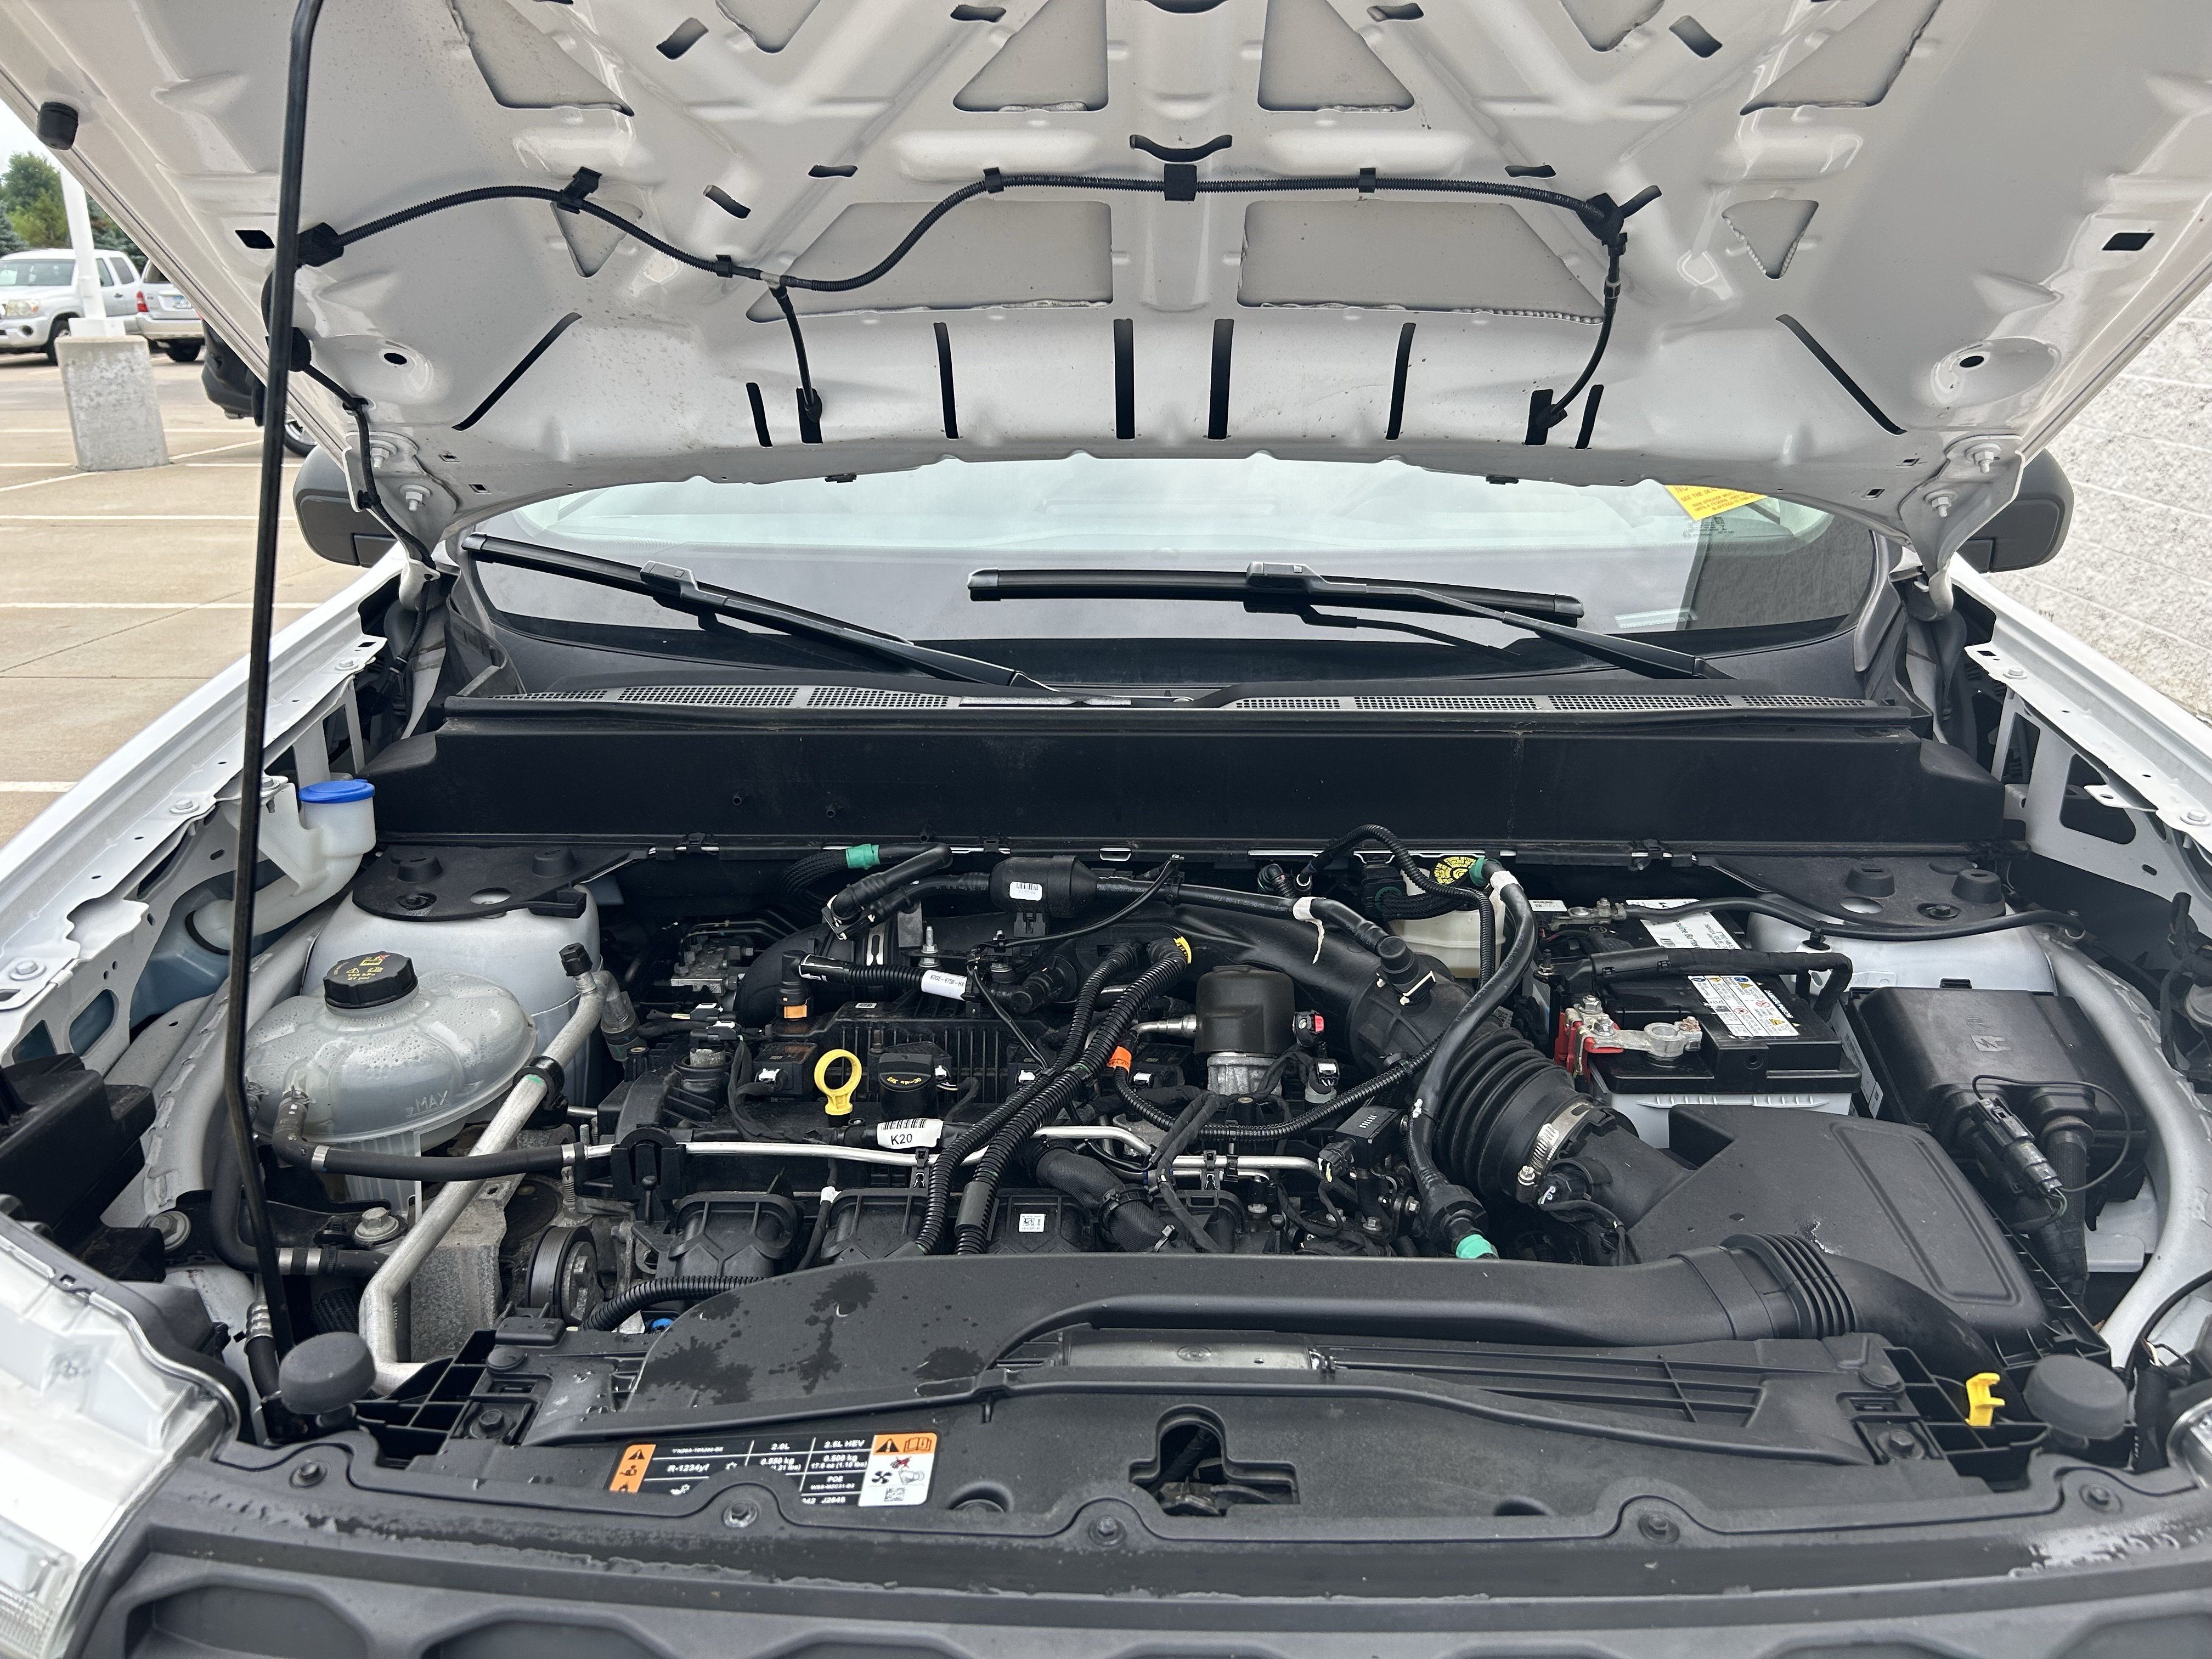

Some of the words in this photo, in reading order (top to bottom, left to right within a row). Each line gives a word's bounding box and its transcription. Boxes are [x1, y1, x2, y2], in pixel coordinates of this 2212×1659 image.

[415, 1089, 451, 1112] MAX
[890, 1133, 912, 1145] K20
[784, 1457, 795, 1465] kg
[847, 1454, 857, 1462] kg
[667, 1463, 710, 1472] R-1234yf
